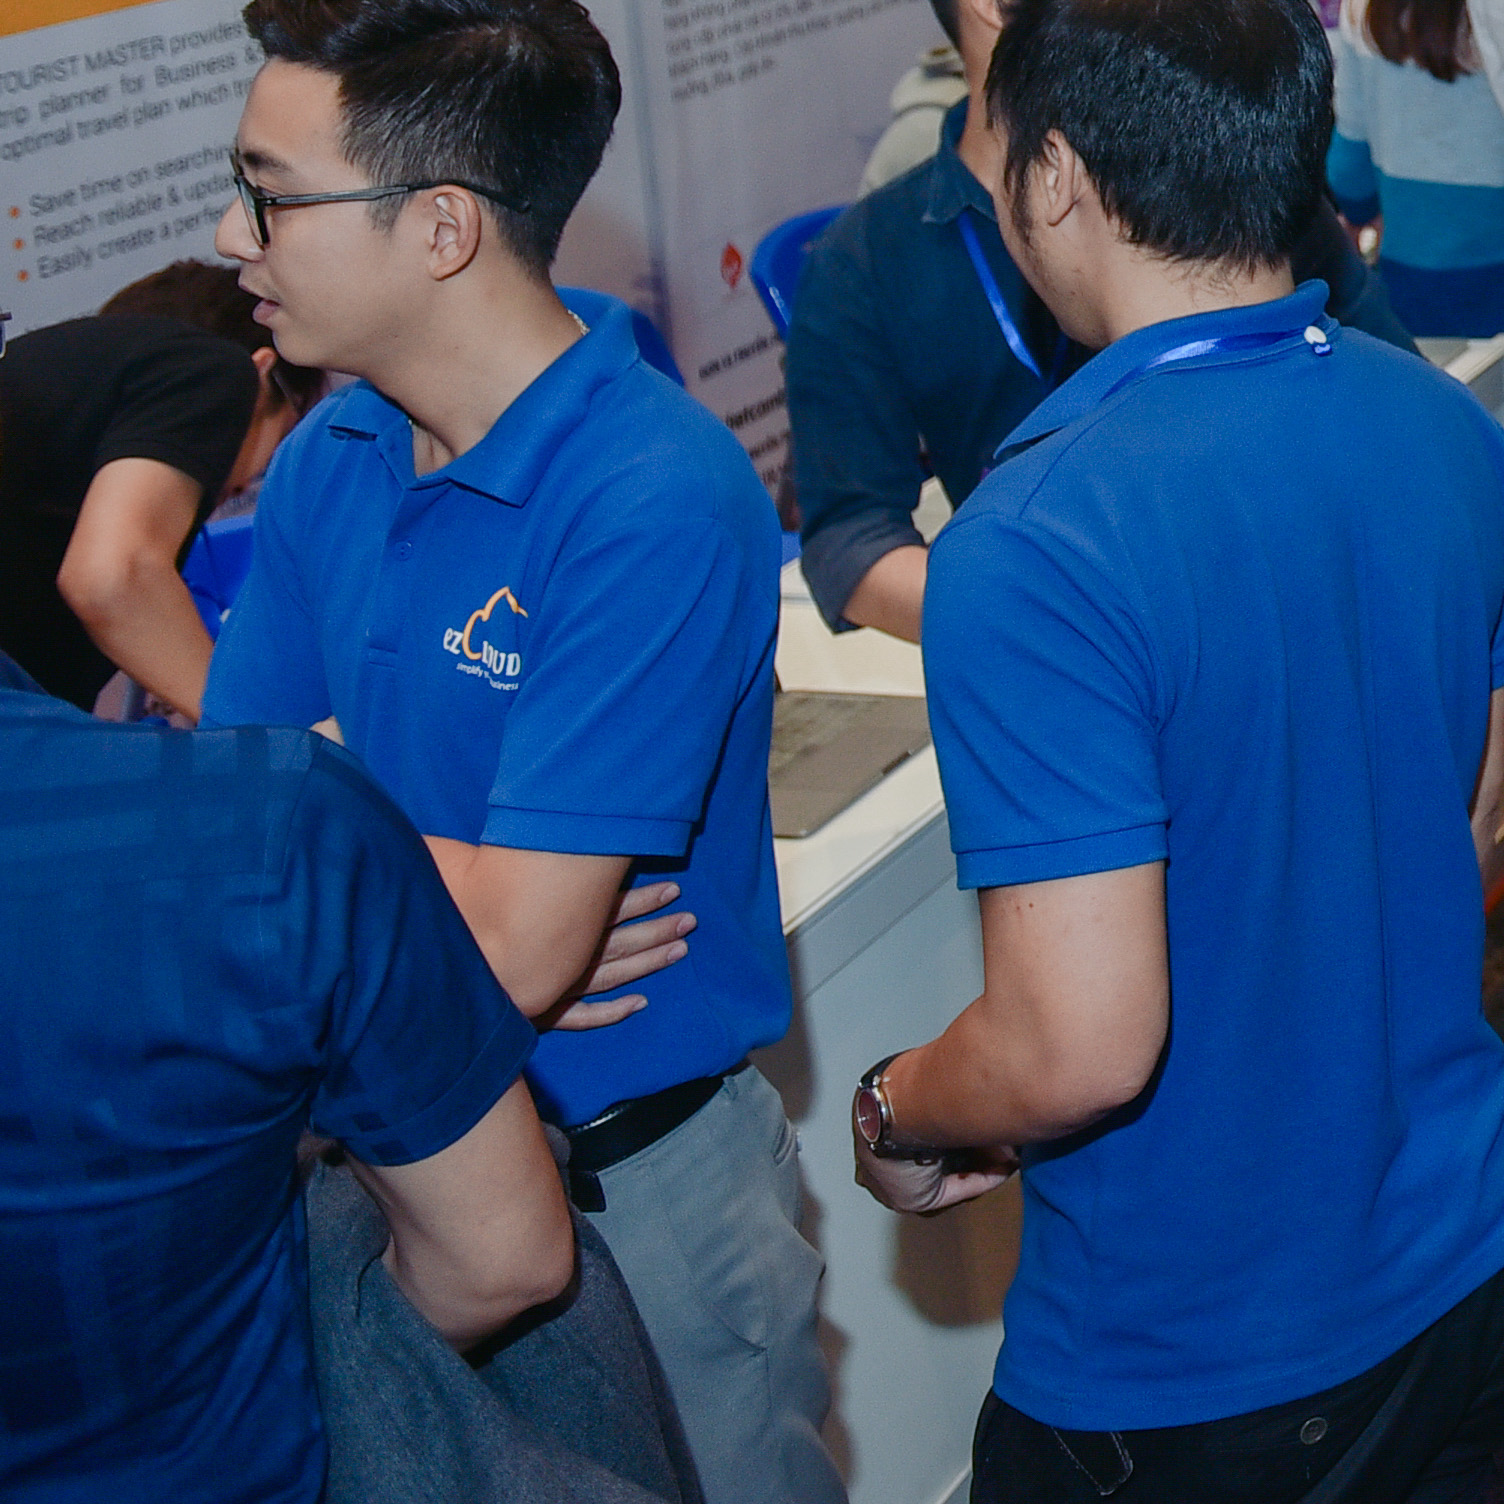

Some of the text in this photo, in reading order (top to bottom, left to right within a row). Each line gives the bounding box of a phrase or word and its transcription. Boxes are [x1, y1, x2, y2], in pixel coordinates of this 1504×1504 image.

[83, 35, 166, 72] MASTER
[169, 22, 243, 55] provides
[154, 53, 237, 88] Business
